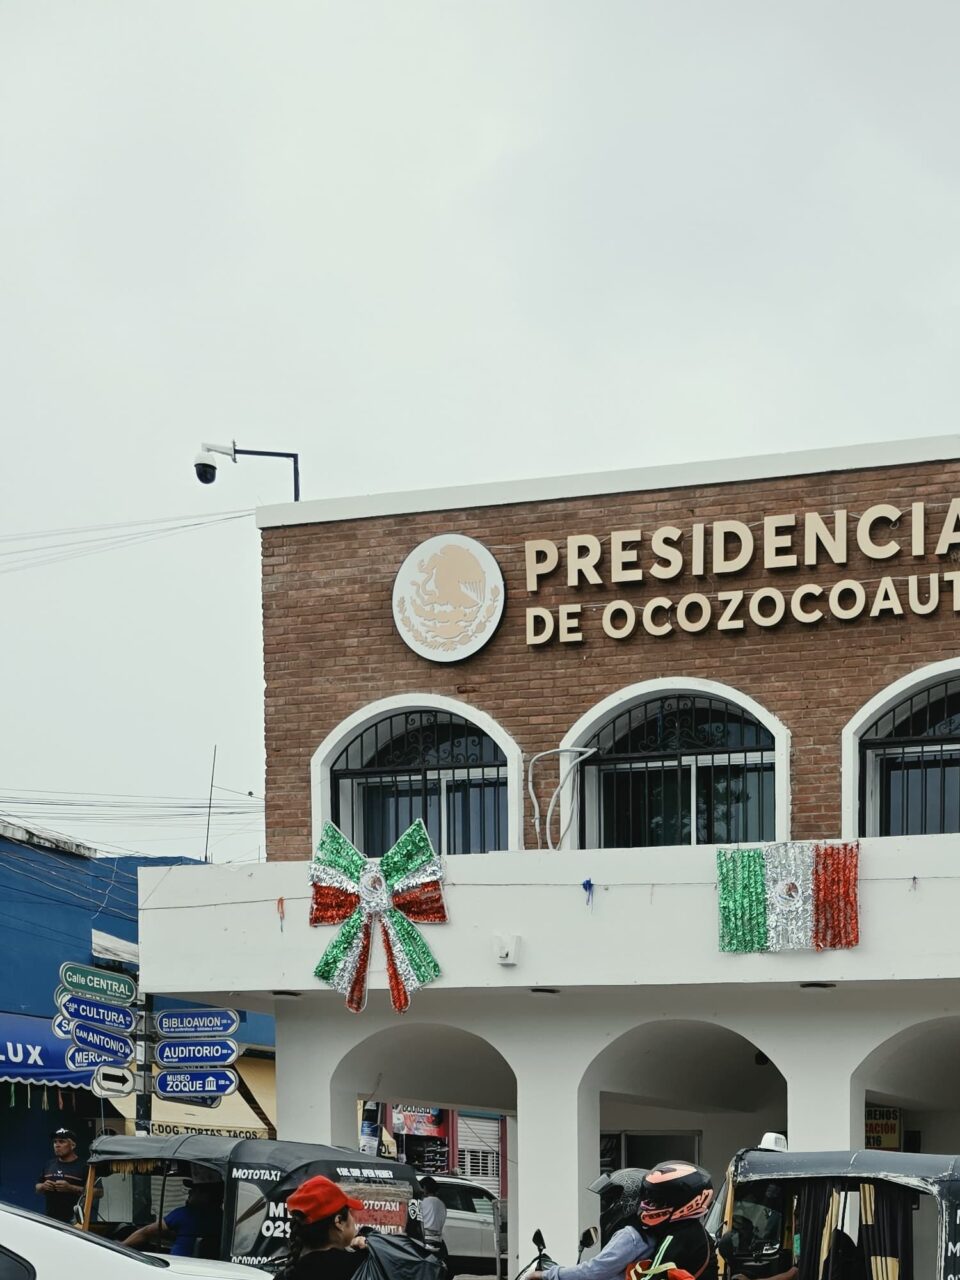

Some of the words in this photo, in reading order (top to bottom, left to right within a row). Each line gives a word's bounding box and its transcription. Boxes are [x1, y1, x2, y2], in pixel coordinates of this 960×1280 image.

[526, 603, 583, 645] DE
[66, 971, 86, 985] Calle
[86, 975, 131, 995] CENTRAL
[79, 1005, 125, 1024] CULTURA
[162, 1016, 221, 1028] BIBLIOAVION
[76, 1029, 88, 1040] SAN
[87, 1031, 125, 1054] ANTONIO
[163, 1045, 222, 1058] AUDITORIO
[166, 1074, 191, 1082] MUSEO
[166, 1080, 203, 1092] ZOQUE
[231, 1167, 281, 1182] MOTOTAXI
[361, 1200, 400, 1212] OTOTAXI
